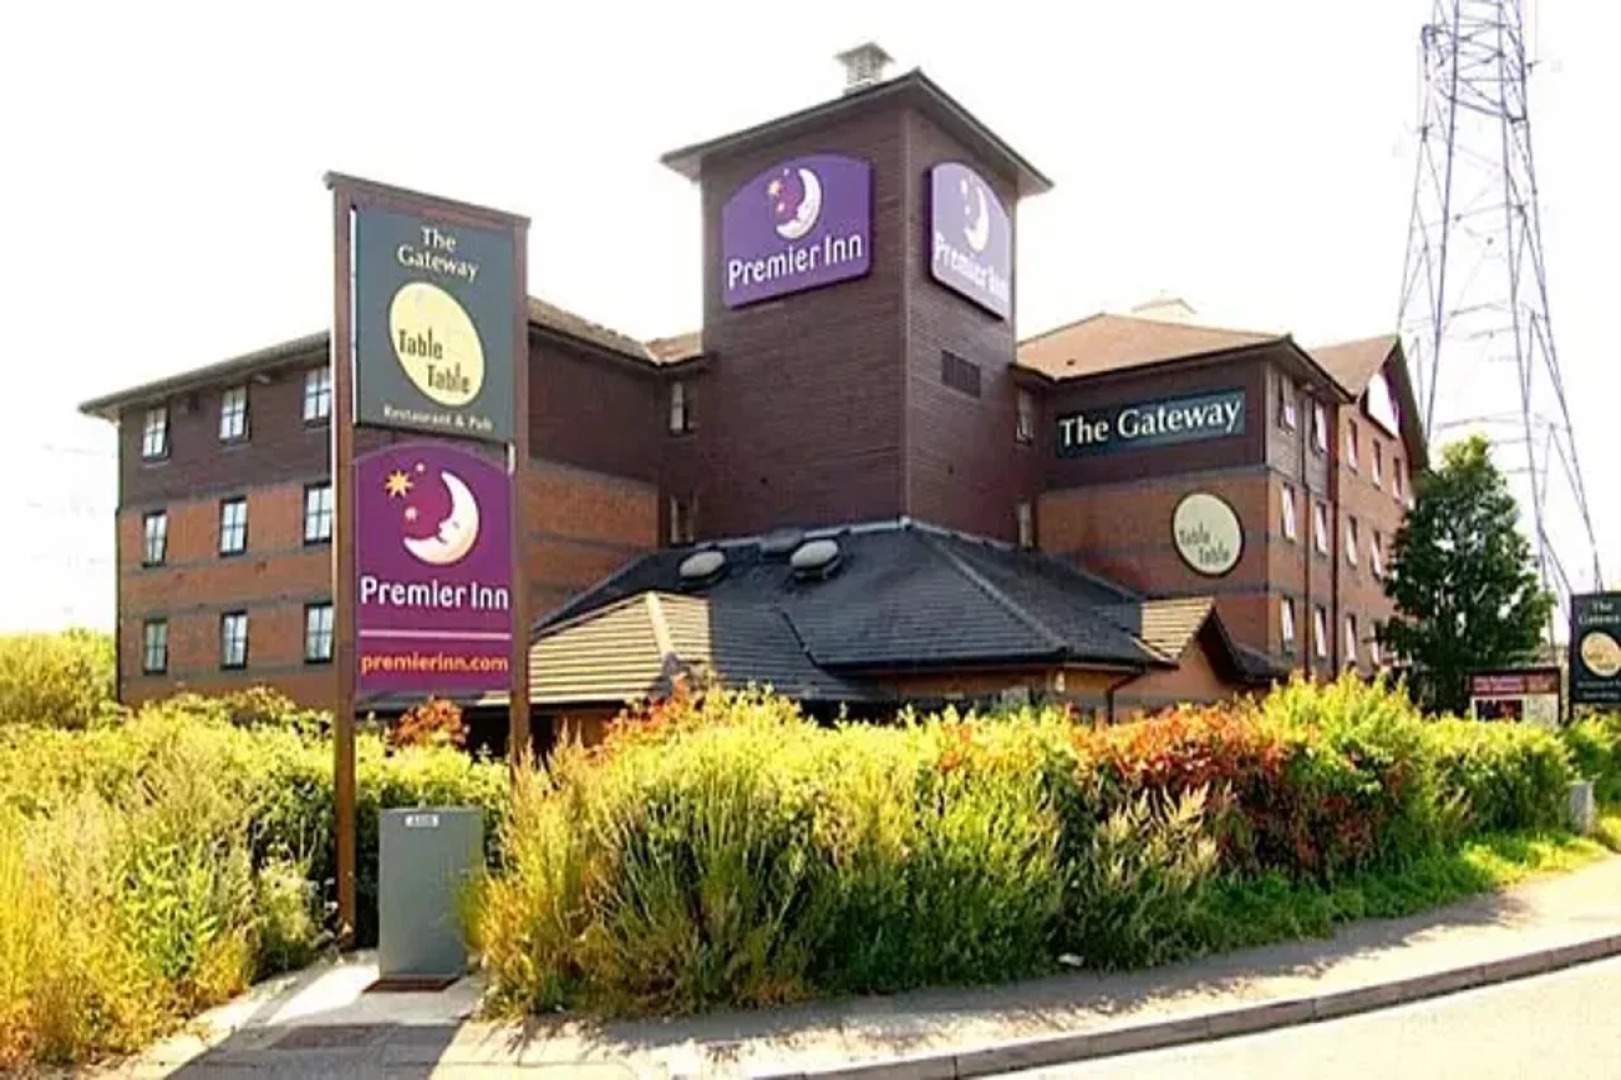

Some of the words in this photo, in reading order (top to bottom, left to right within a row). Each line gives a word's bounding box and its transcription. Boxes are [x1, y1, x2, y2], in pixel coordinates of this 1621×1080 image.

[421, 226, 456, 251] The
[397, 243, 480, 282] Gateway
[728, 244, 820, 290] Premier
[825, 233, 862, 266] Inn
[935, 231, 987, 291] Premier
[399, 328, 443, 359] Table
[427, 363, 470, 395] Table
[383, 403, 451, 426] Restaurant
[455, 412, 464, 428] &
[470, 414, 493, 432] Pub
[1058, 415, 1110, 447] The
[1117, 400, 1241, 438] Gateway
[1179, 521, 1210, 547] Table
[1199, 540, 1231, 565] Table
[361, 576, 467, 608] Premier
[472, 582, 509, 610] Inn
[361, 652, 509, 675] premierinn.com
